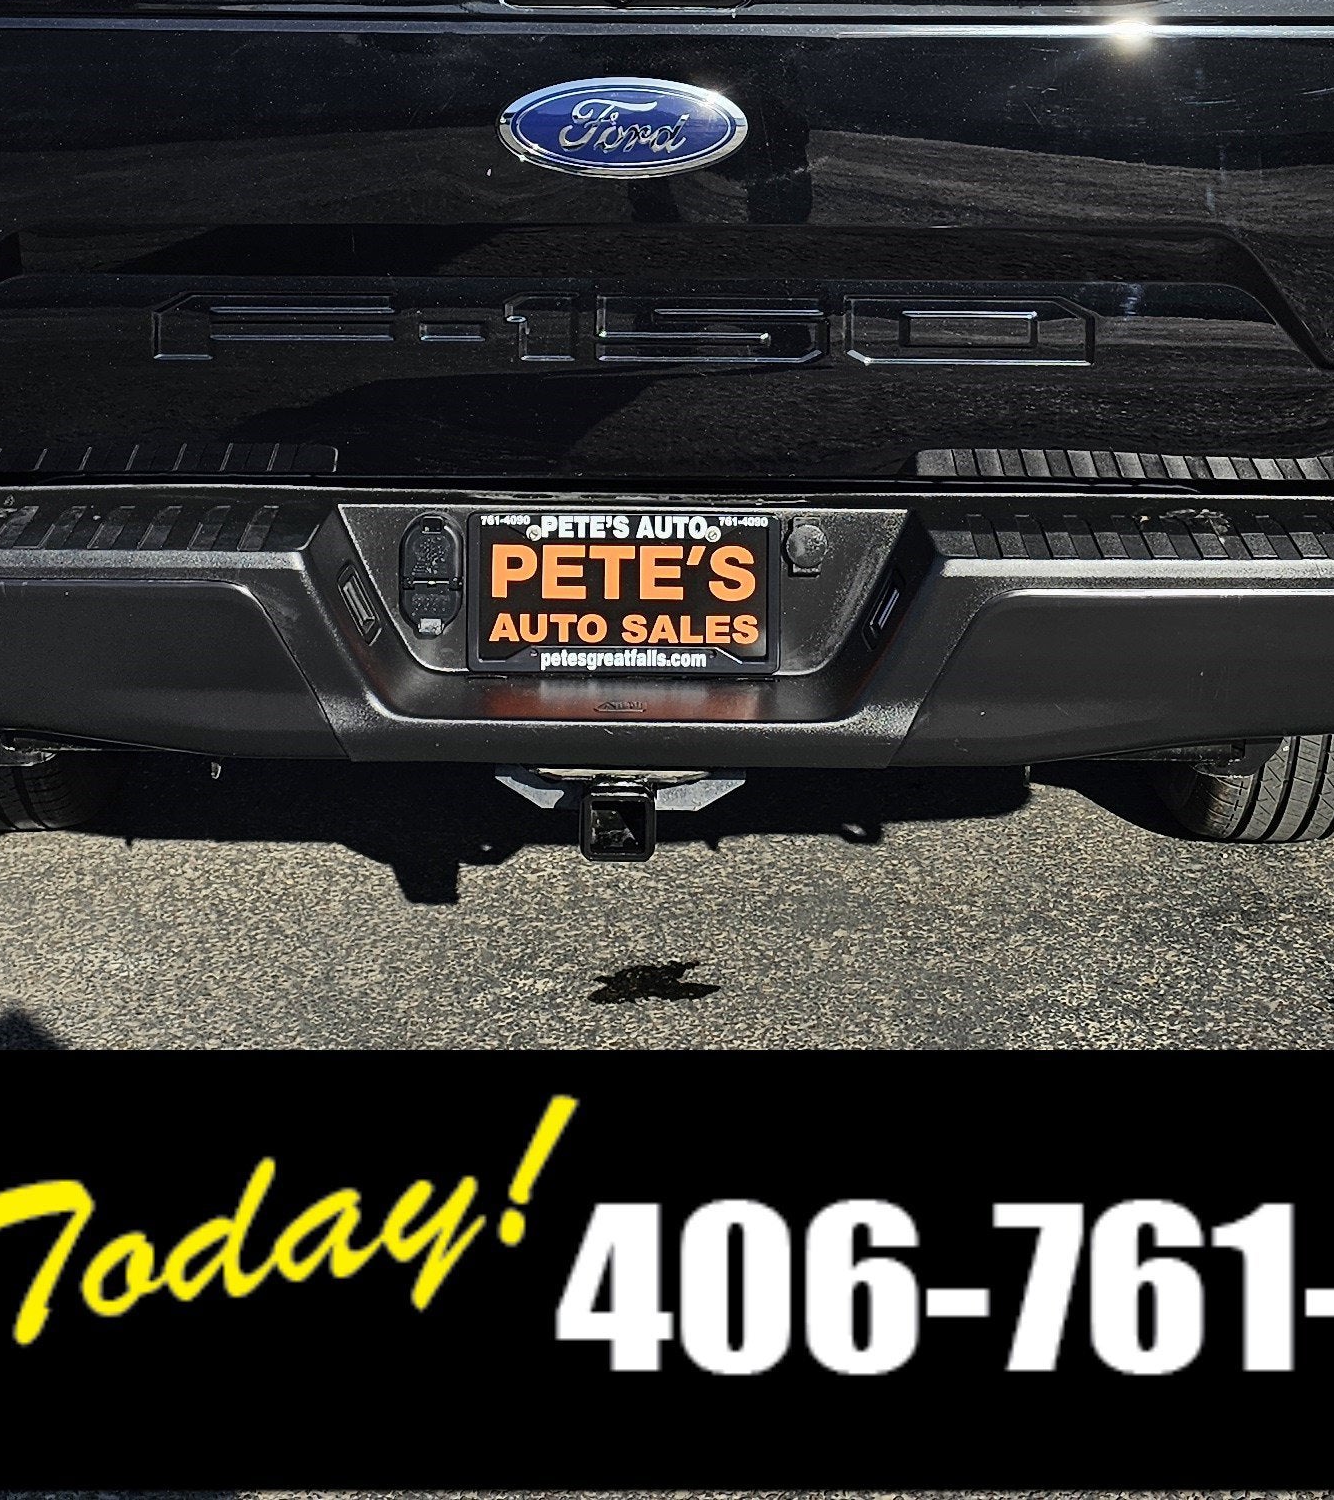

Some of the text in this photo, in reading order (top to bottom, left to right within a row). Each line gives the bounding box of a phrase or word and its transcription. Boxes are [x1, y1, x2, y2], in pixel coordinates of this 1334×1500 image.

[558, 98, 690, 153] Ford
[153, 290, 1097, 366] F-150
[481, 515, 531, 526] 761-4090
[540, 515, 708, 540] PETE'S AUTO
[719, 516, 769, 528] 761-4090
[491, 544, 756, 601] PETE'S
[488, 613, 759, 645] AUTO SALES
[540, 649, 707, 671] petesgreatfalls.com
